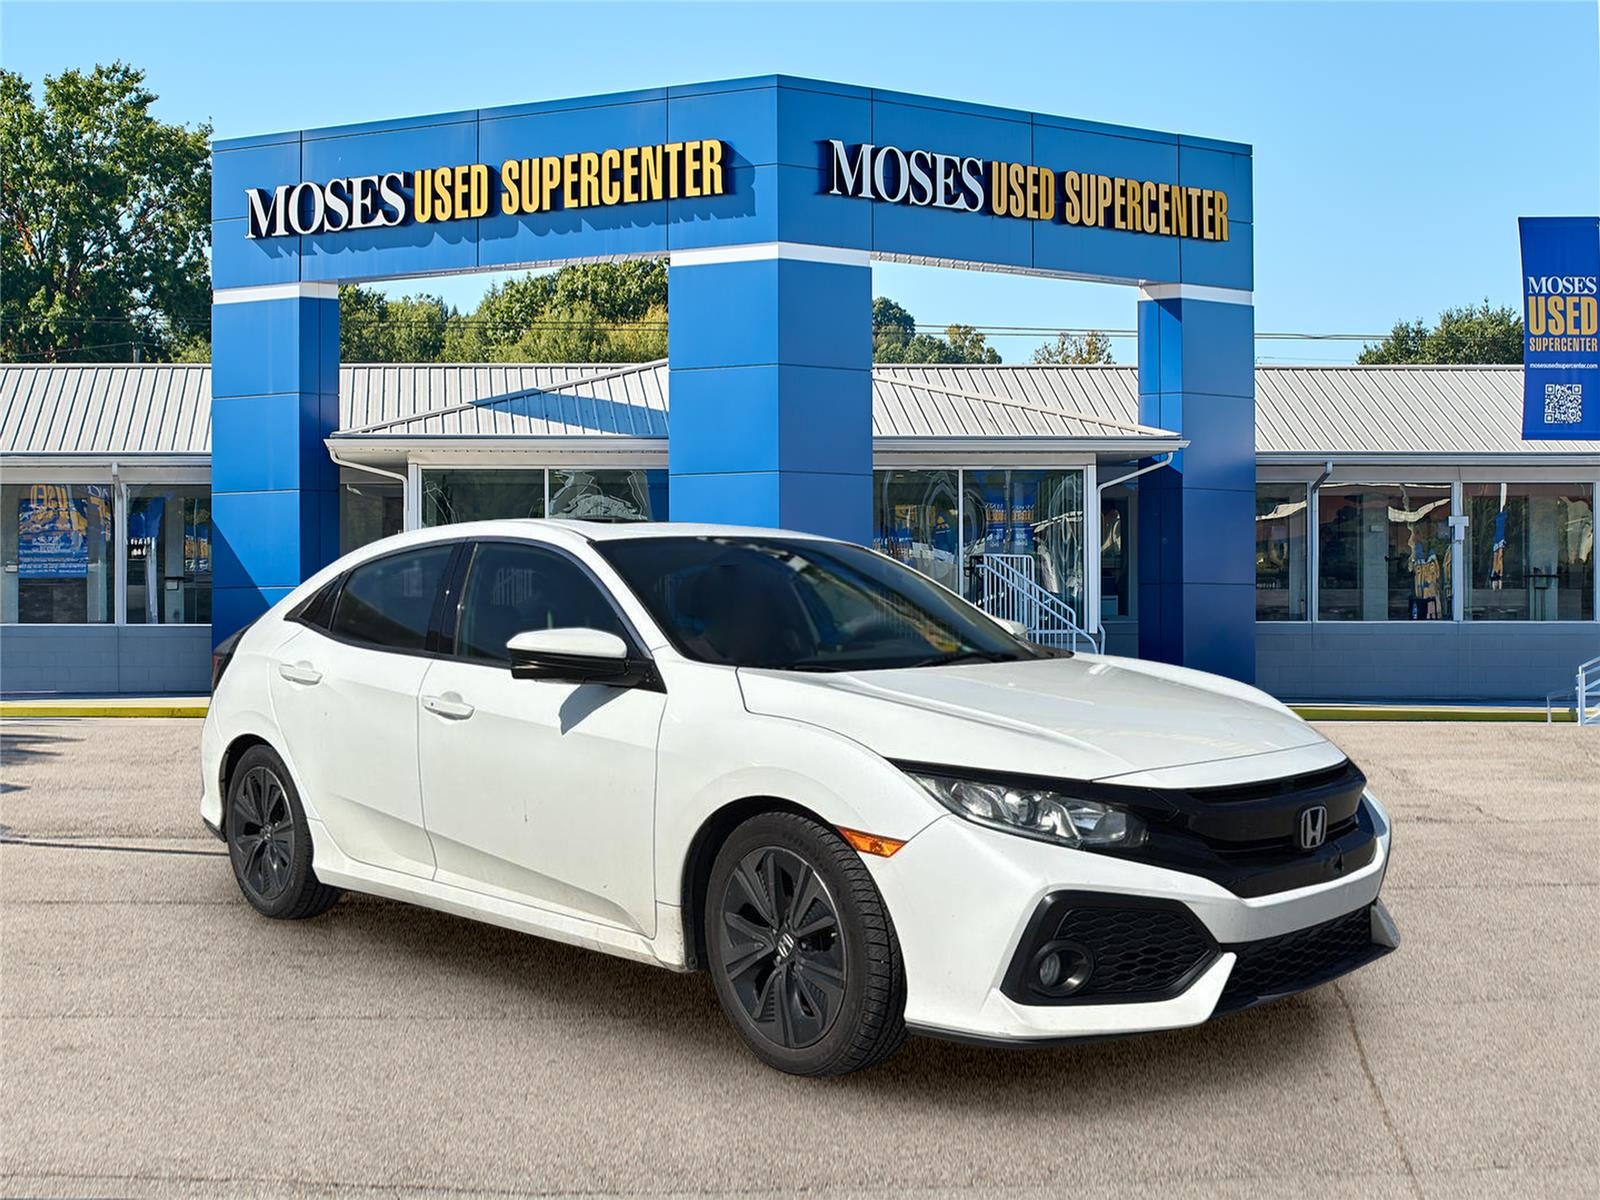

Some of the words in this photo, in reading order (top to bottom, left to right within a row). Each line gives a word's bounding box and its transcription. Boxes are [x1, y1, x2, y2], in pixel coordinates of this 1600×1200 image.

[245, 173, 406, 239] MOSES
[414, 164, 488, 223] USED
[501, 139, 723, 216] SUPERCENTER
[829, 139, 984, 213] MOSES
[991, 160, 1055, 221] USED
[1065, 170, 1229, 242] SUPERCENTER
[1528, 276, 1597, 294] MOSES
[1529, 296, 1598, 335] USED
[1529, 337, 1598, 352] SUPERCENTER
